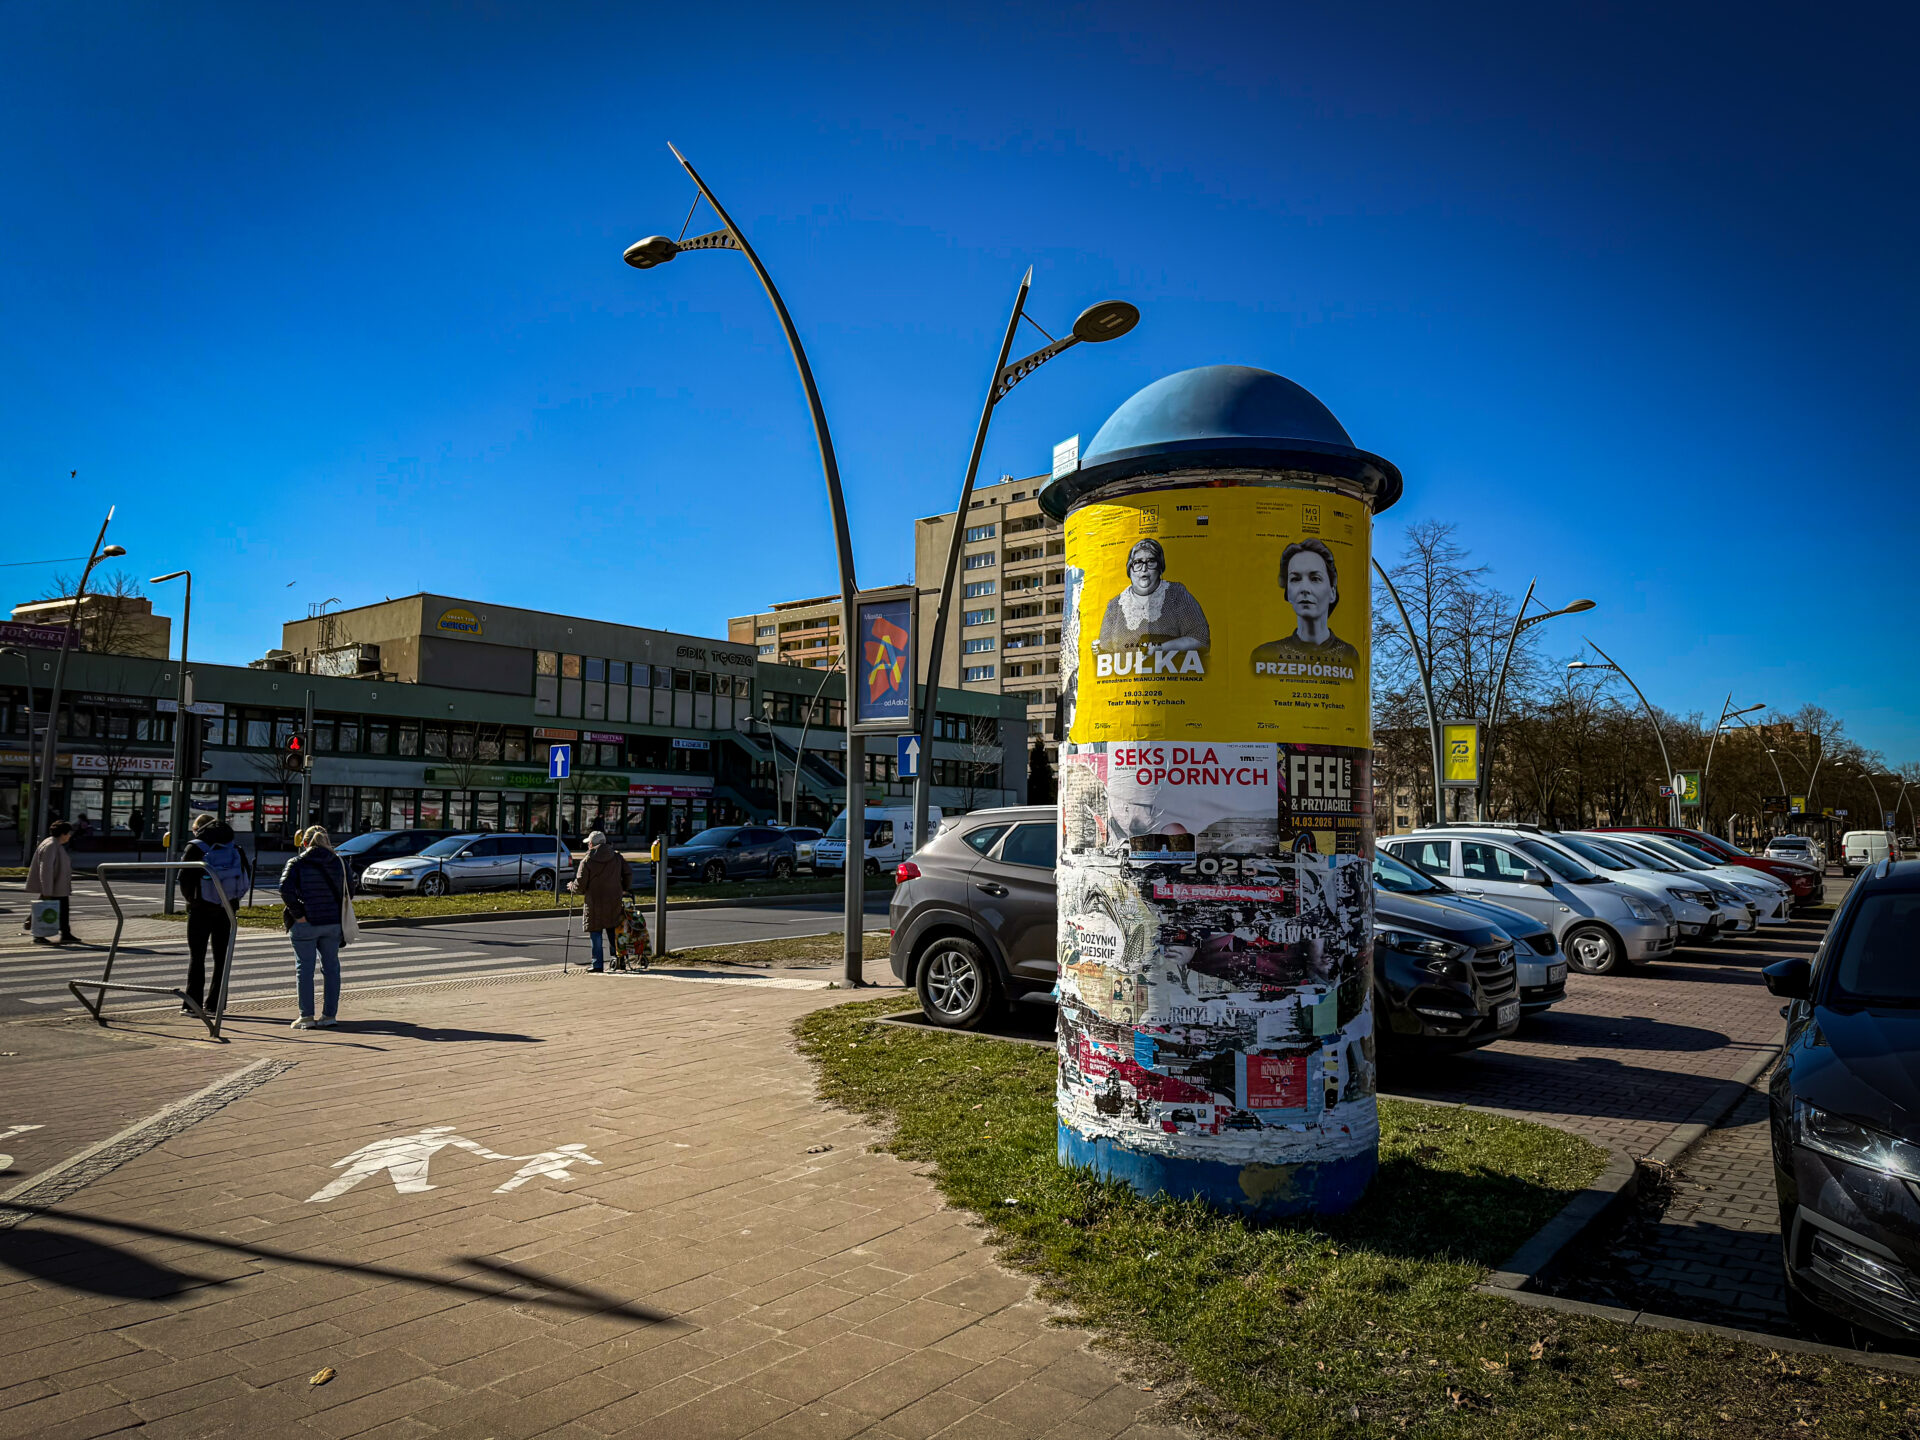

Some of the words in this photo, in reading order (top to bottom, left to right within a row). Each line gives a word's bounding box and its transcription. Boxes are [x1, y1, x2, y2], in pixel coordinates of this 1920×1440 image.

[1097, 649, 1205, 677] BUŁKA
[1255, 662, 1354, 680] PRZEPIÓRSKA
[1123, 690, 1163, 698] 19.03.2026
[1291, 691, 1330, 699] 22.03.2026
[1126, 699, 1142, 707] Mały
[1152, 698, 1185, 706] Tychach
[1294, 700, 1311, 708] Mały
[1321, 702, 1345, 710] Tychach
[1114, 747, 1165, 766] SEKS
[1172, 747, 1219, 765] DLA
[510, 774, 542, 785] żabka
[1136, 767, 1269, 786] OPORNYCH
[1290, 755, 1351, 798] FEEL
[1344, 776, 1351, 788] 20
[1291, 798, 1298, 811] &
[1300, 798, 1351, 812] PRZYJACIELE
[1290, 816, 1333, 827] 14.03.2026
[1156, 886, 1187, 897] SILNA
[1191, 887, 1235, 898] BOGATA
[1080, 931, 1117, 947] DOŻYNKI
